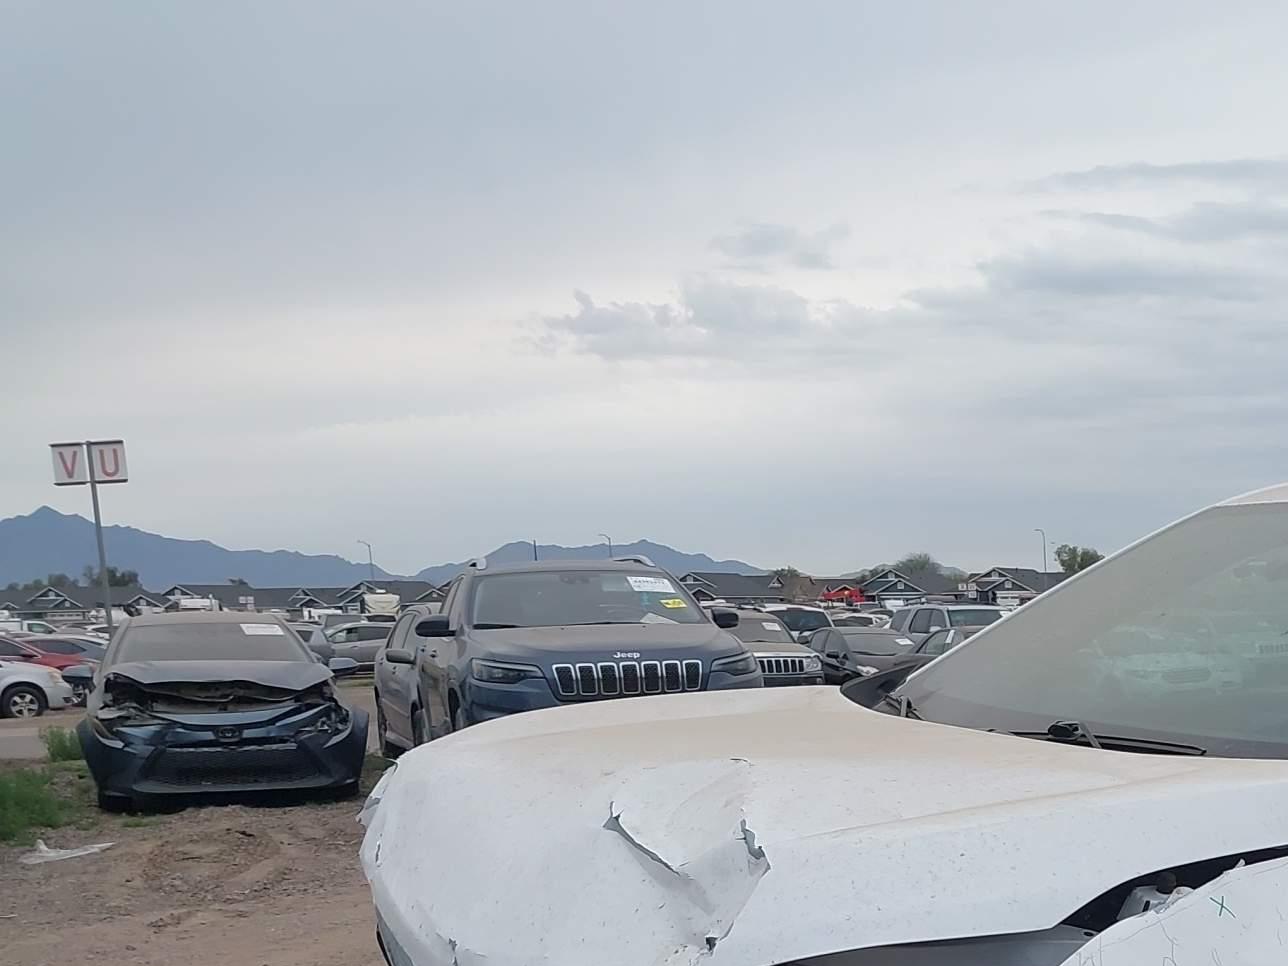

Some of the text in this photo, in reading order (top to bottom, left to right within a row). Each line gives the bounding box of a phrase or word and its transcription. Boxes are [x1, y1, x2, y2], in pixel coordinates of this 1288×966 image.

[57, 450, 78, 479] V
[99, 448, 120, 477] U
[613, 651, 641, 659] Jeep
